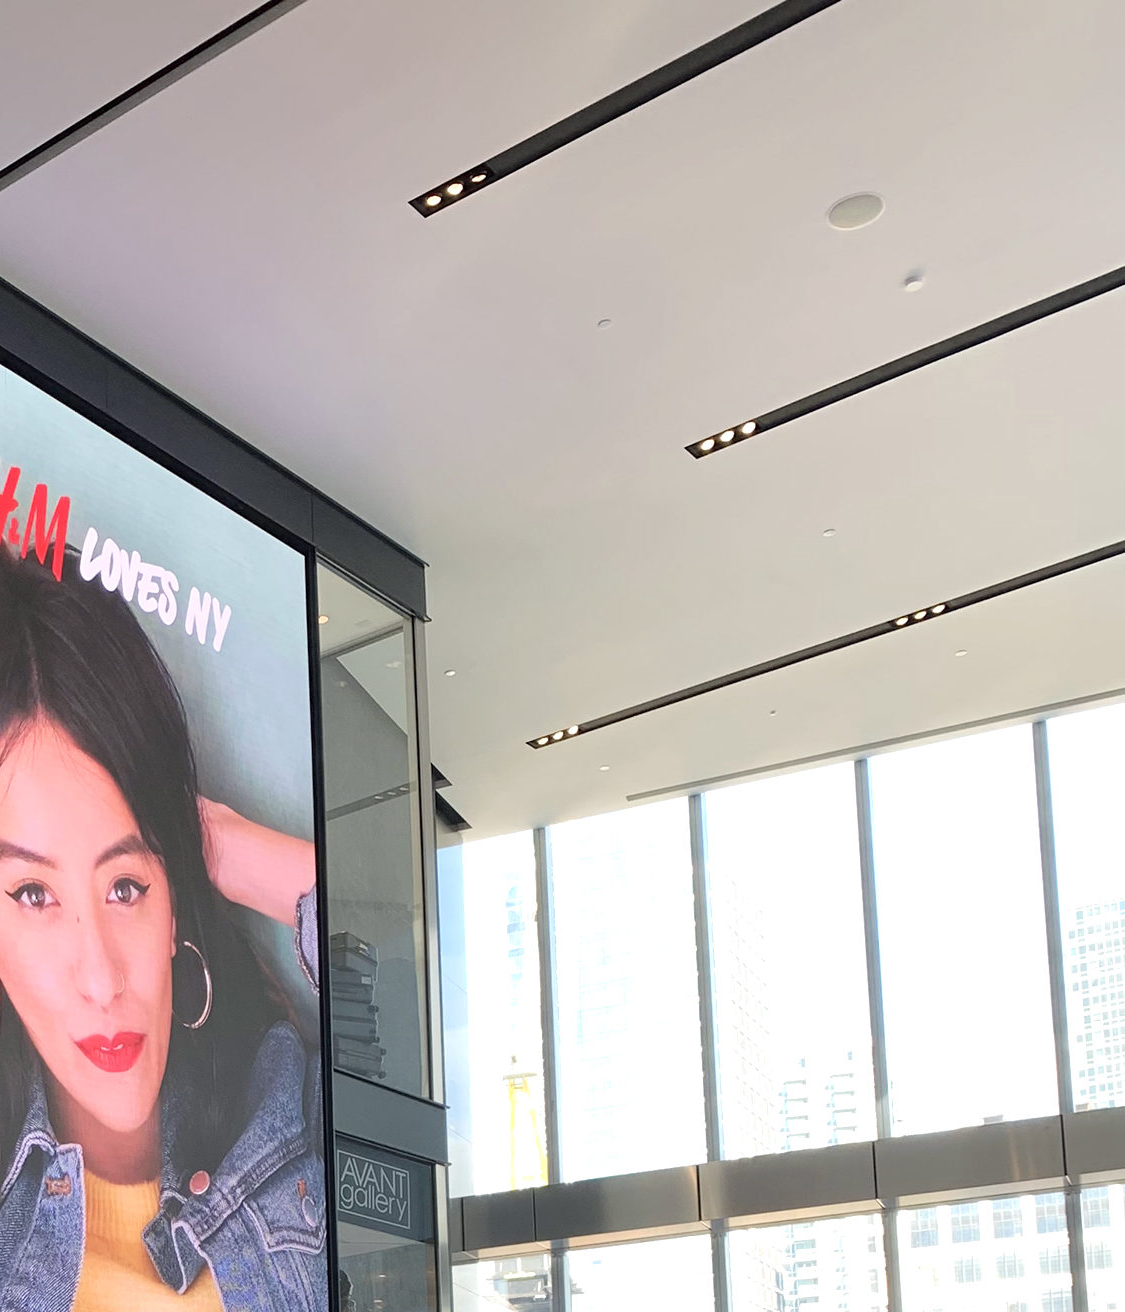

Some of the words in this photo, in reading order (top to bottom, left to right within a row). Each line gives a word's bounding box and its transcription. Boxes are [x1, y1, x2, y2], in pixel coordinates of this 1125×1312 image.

[80, 527, 179, 625] LOVES
[185, 587, 232, 652] NY
[340, 1157, 407, 1199] AVANT
[340, 1183, 407, 1222] gallery
